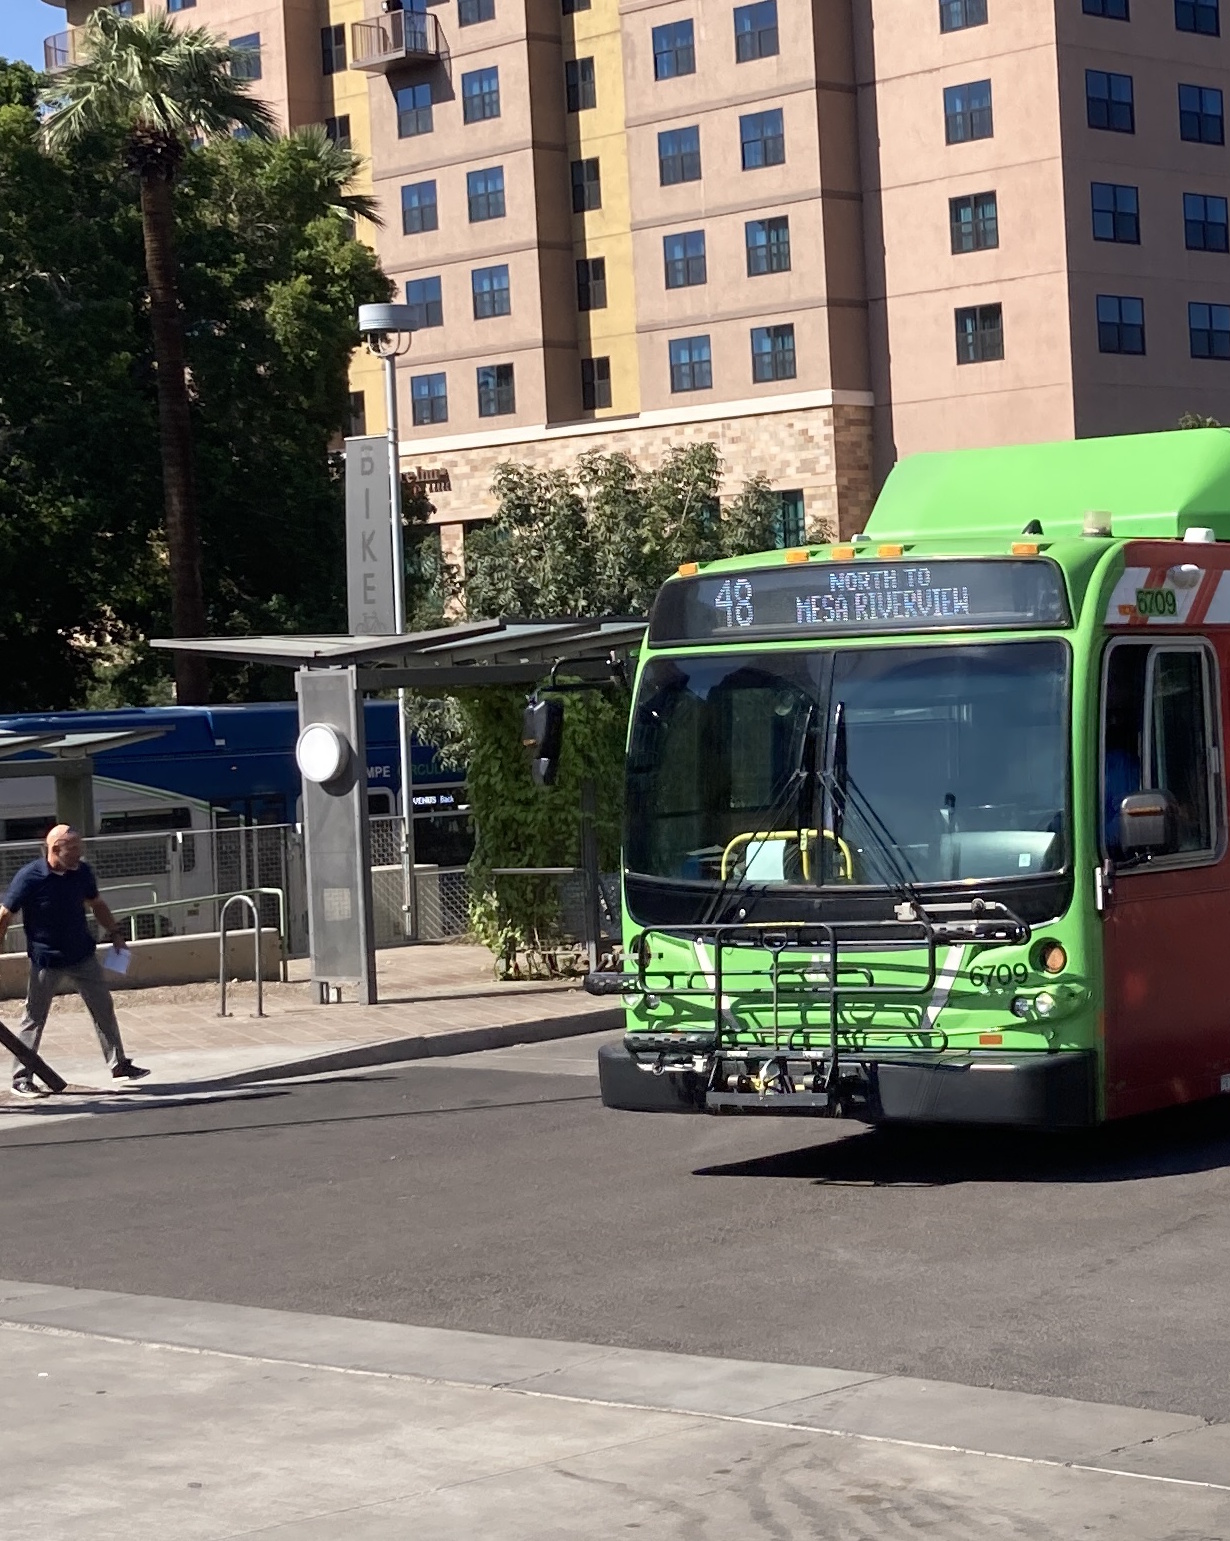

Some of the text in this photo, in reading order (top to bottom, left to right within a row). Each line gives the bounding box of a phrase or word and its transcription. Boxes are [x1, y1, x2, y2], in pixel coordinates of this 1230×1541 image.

[360, 445, 378, 605] BIKE
[829, 567, 931, 591] NORTH TO
[715, 578, 754, 627] 48
[796, 586, 969, 623] MESA RIVERVIEW
[1135, 589, 1177, 615] 6709
[969, 962, 1029, 987] 6709
